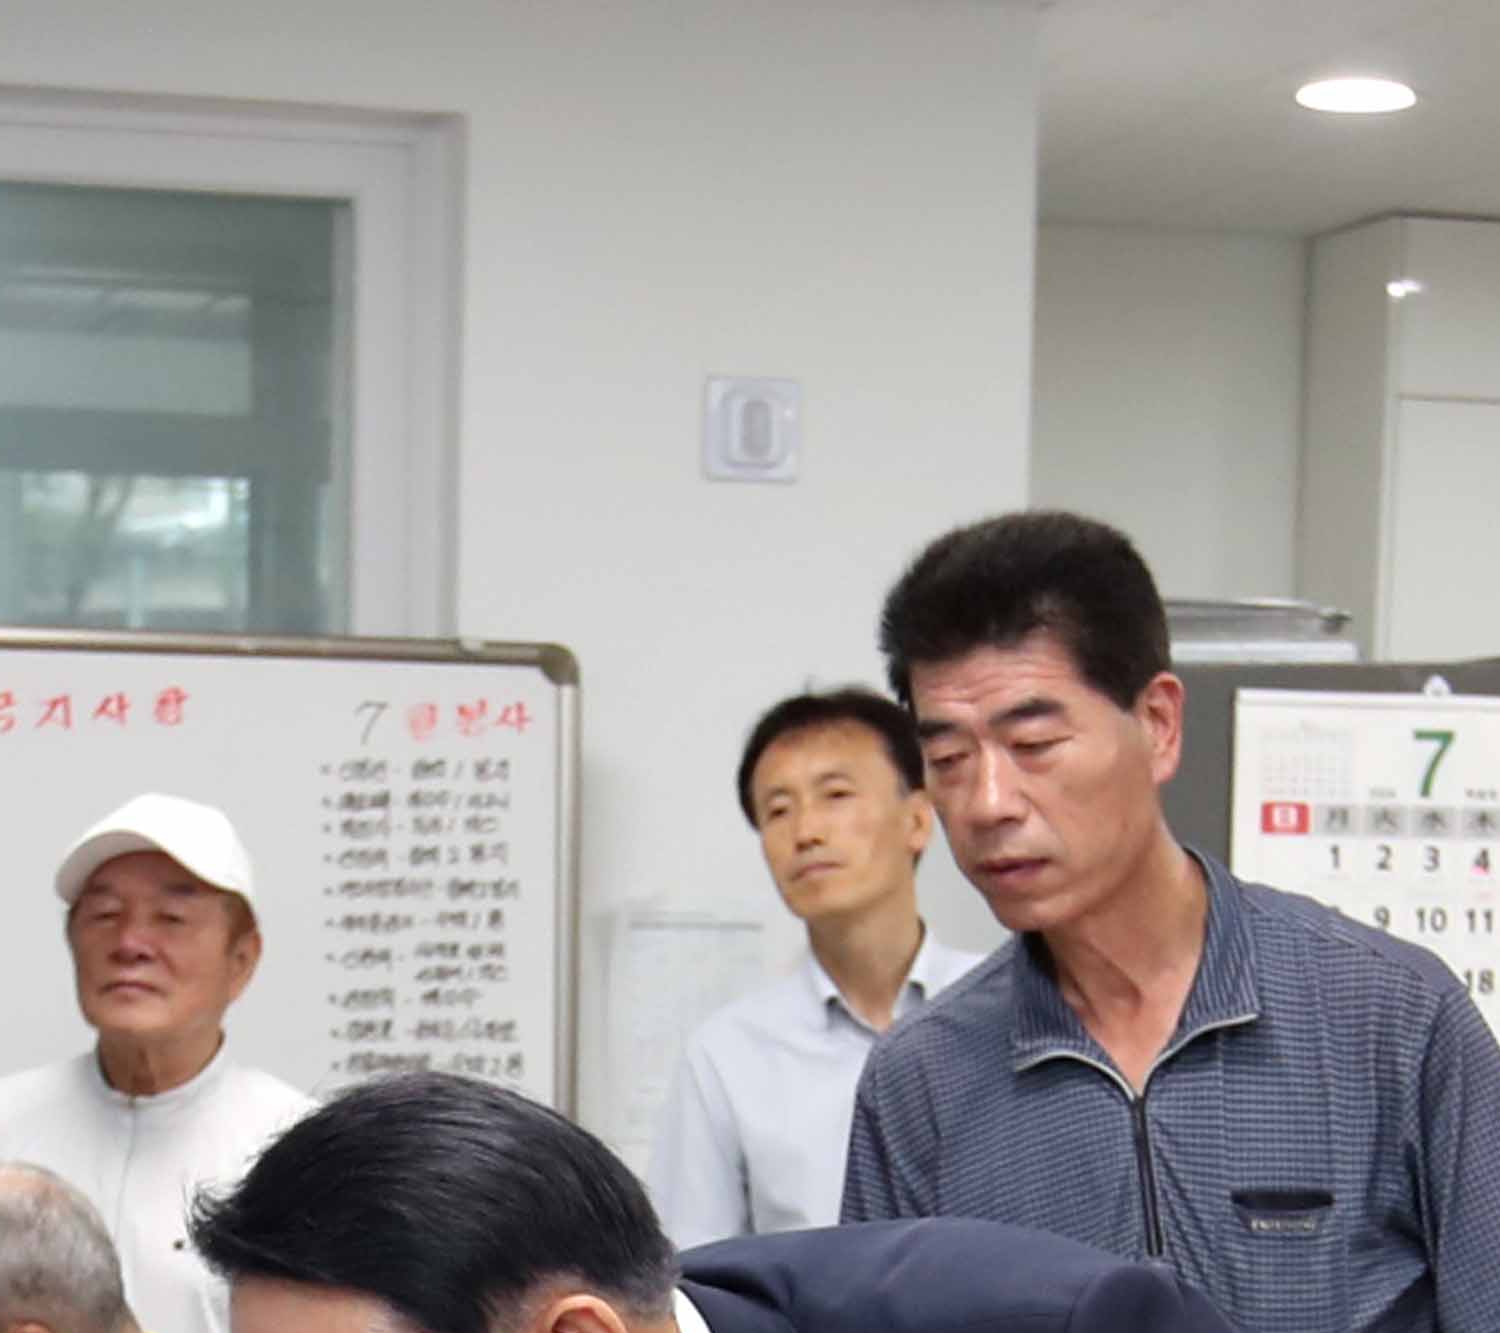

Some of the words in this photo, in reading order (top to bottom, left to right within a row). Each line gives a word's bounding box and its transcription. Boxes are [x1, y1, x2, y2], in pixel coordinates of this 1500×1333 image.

[353, 699, 389, 744] 7
[1413, 729, 1456, 797] 7
[1330, 845, 1341, 869] 1
[1377, 846, 1393, 871] 2
[1423, 847, 1440, 872] 3
[1474, 848, 1491, 873] 4
[1373, 906, 1391, 931] 9
[1416, 908, 1447, 933] 10
[1466, 909, 1494, 933] 11
